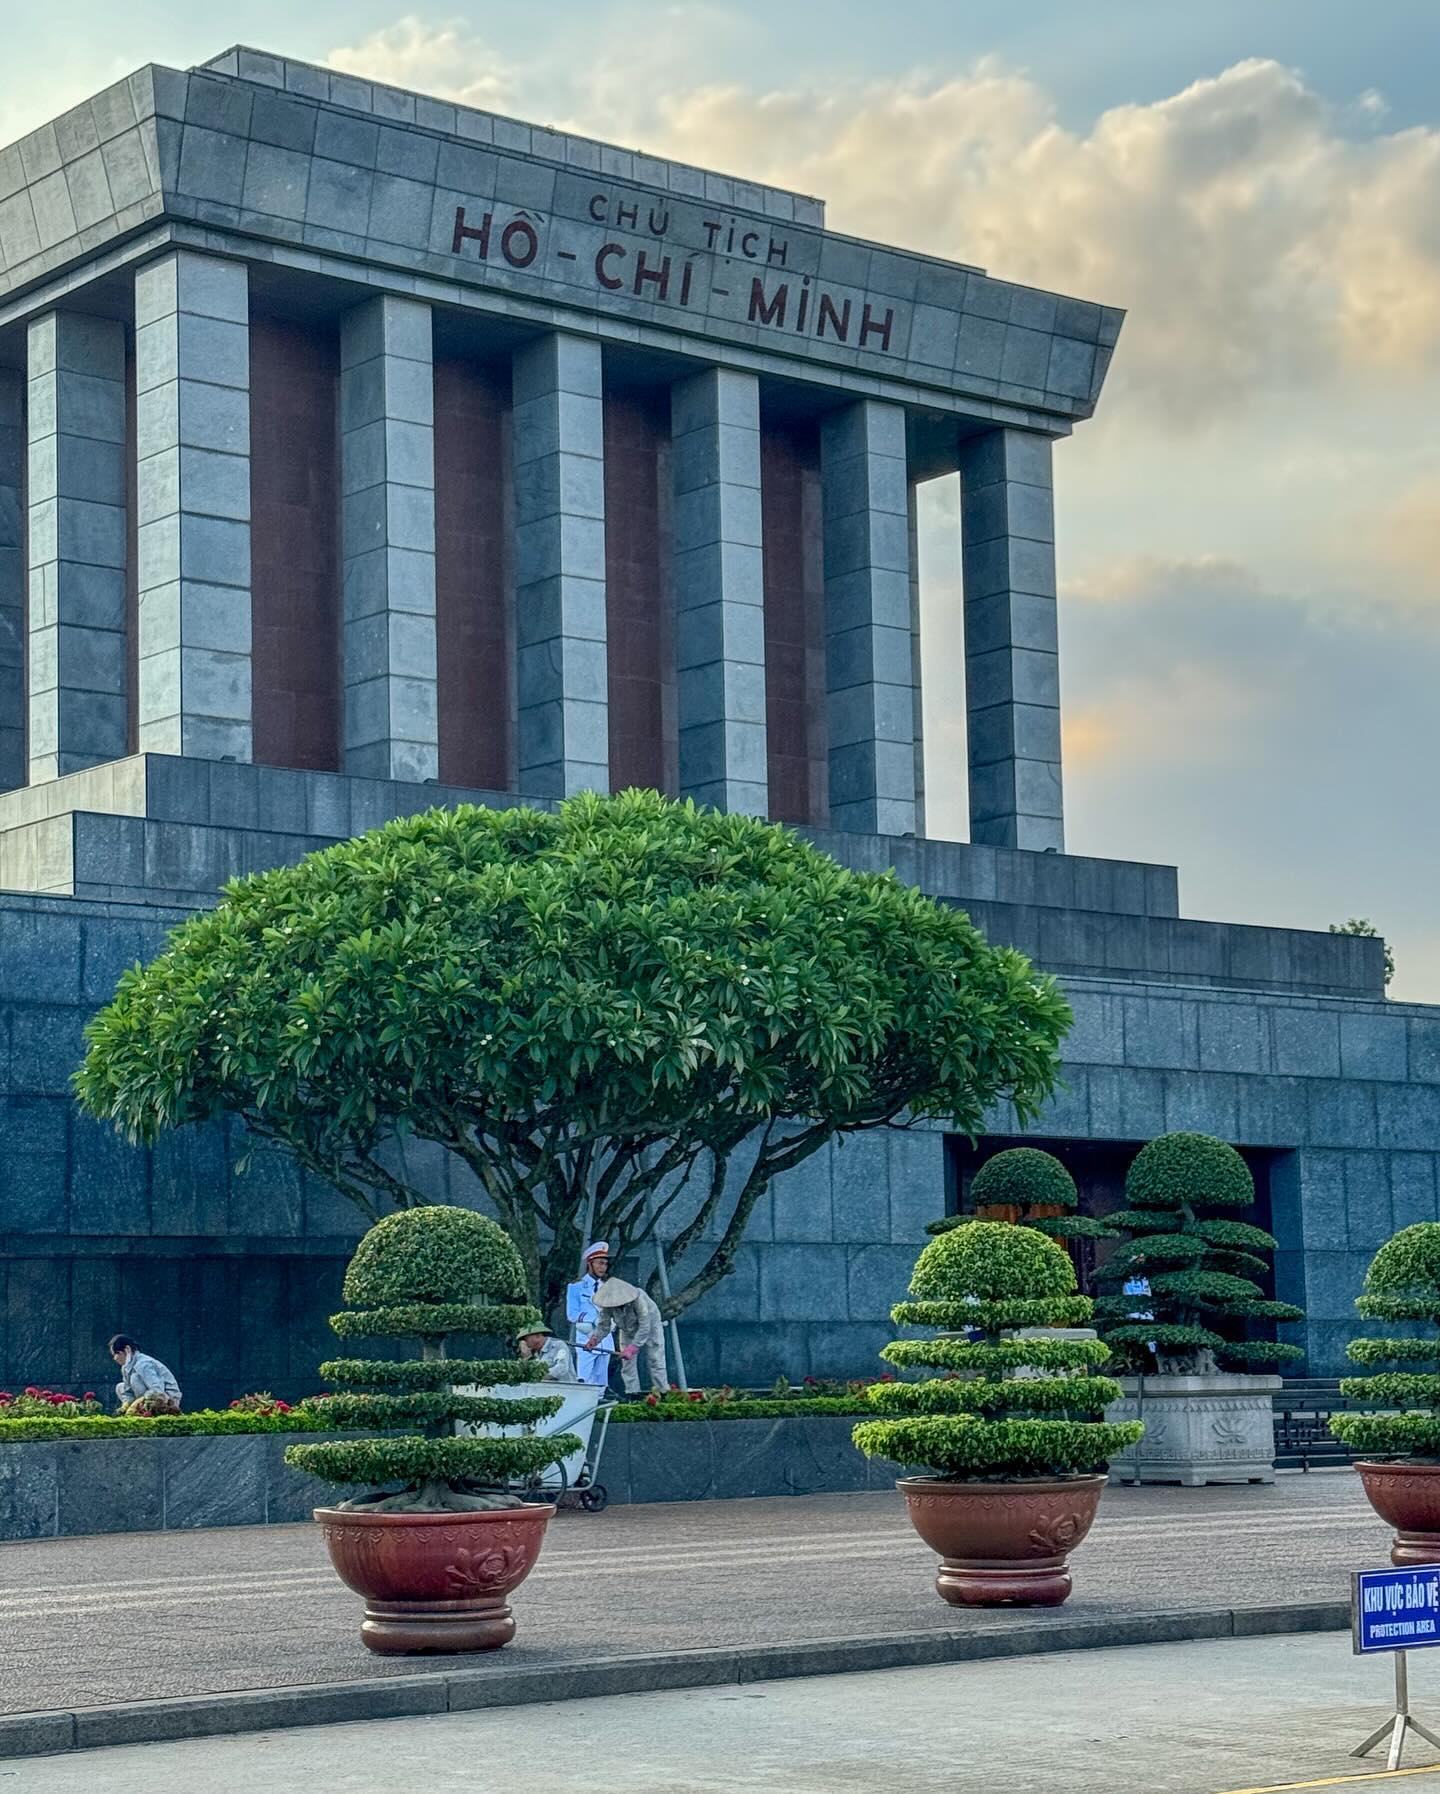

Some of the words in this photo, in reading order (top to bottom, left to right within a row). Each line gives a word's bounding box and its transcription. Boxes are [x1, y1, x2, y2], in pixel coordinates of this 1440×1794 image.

[595, 243, 702, 307] CHÍ
[1364, 1586, 1384, 1613] KHU
[1385, 1582, 1404, 1617] VỰC
[1405, 1575, 1425, 1609] BẢO
[1426, 1576, 1440, 1613] VỆ
[1370, 1621, 1415, 1639] PROTECTION
[1416, 1619, 1436, 1635] AREA
